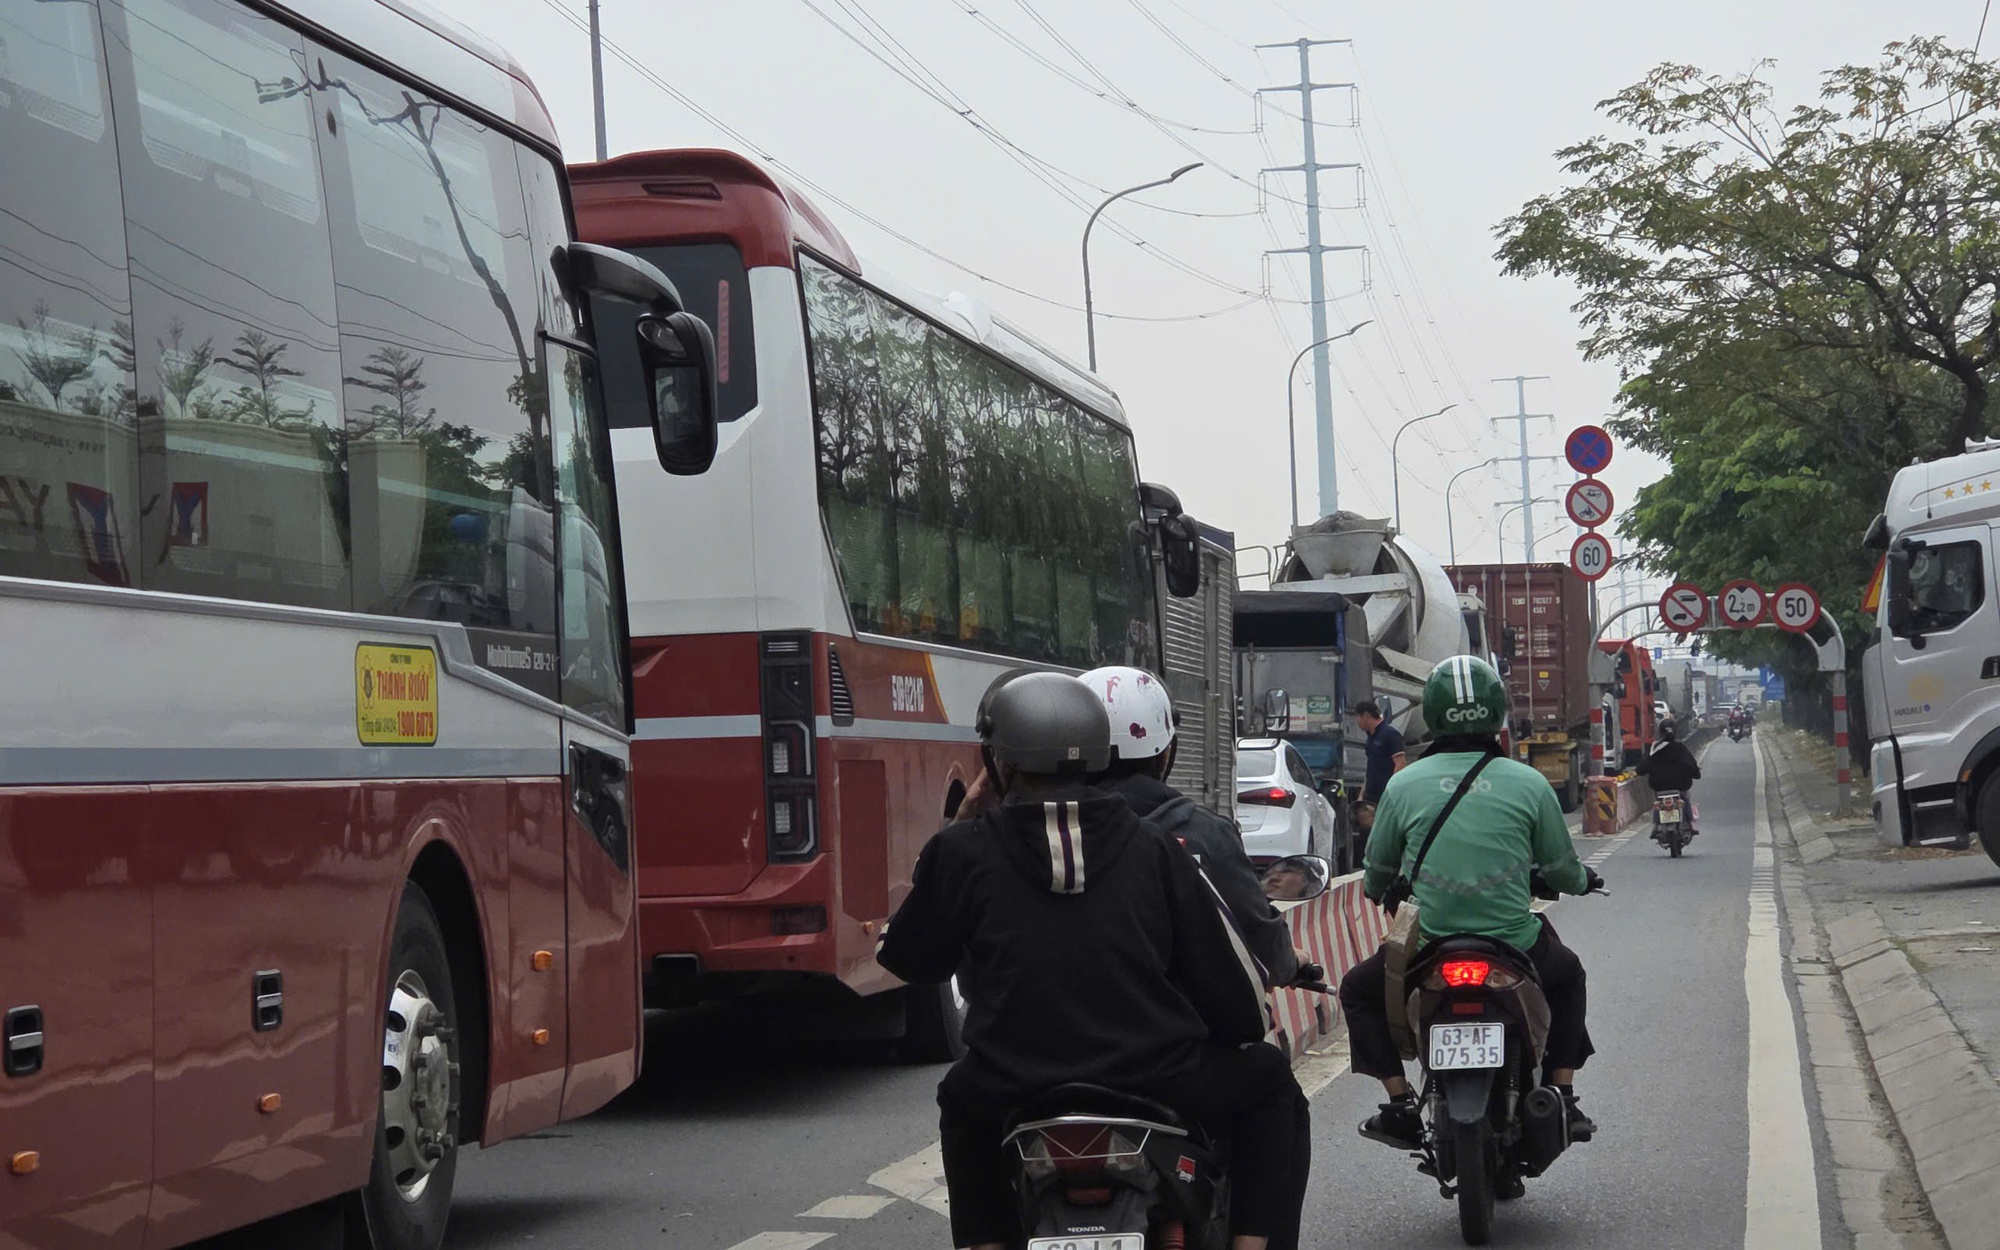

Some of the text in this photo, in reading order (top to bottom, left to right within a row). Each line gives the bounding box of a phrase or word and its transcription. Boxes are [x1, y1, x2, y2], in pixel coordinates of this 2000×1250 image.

[1583, 546, 1600, 567] 60
[1785, 597, 1807, 618] 50
[1446, 703, 1489, 722] Grab
[1440, 777, 1492, 793] Gab
[1442, 1027, 1492, 1046] 63-AF
[1435, 1046, 1499, 1067] 075.35
